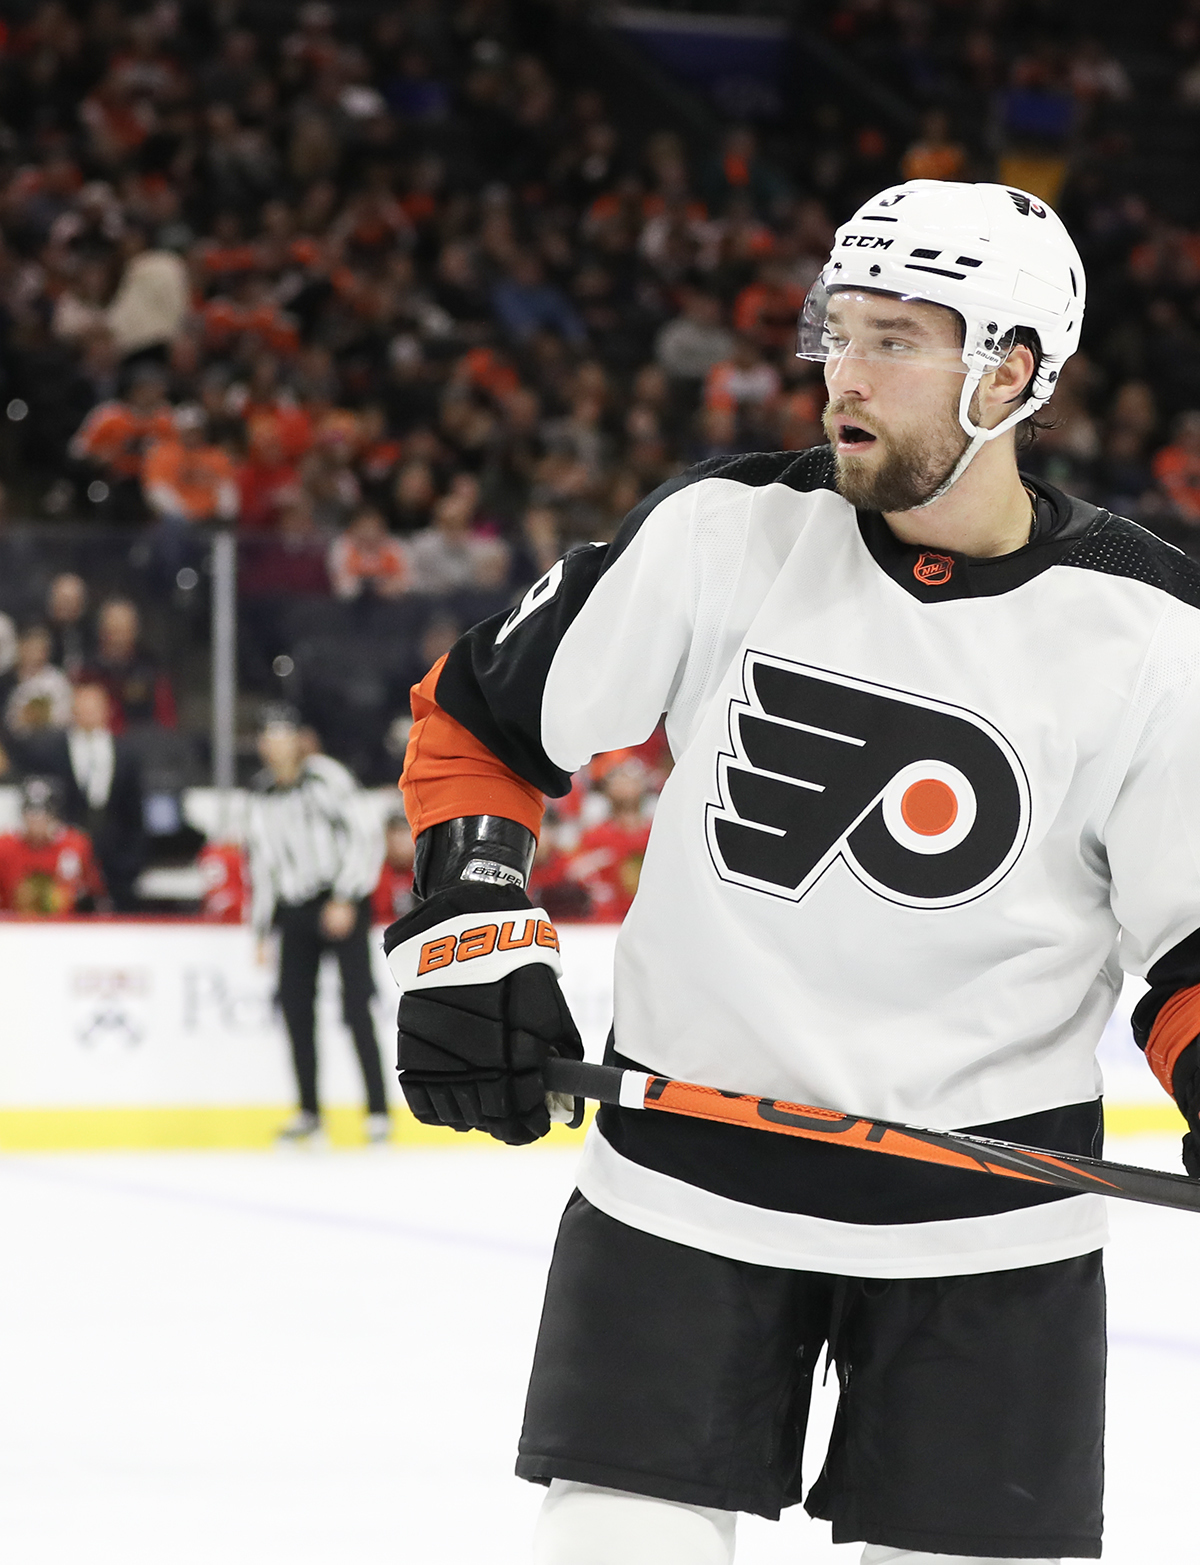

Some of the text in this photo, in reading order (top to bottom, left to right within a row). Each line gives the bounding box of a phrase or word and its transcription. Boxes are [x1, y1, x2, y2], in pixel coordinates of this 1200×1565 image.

[842, 235, 894, 250] CCM
[922, 563, 946, 575] NHL
[417, 919, 560, 977] BAUE
